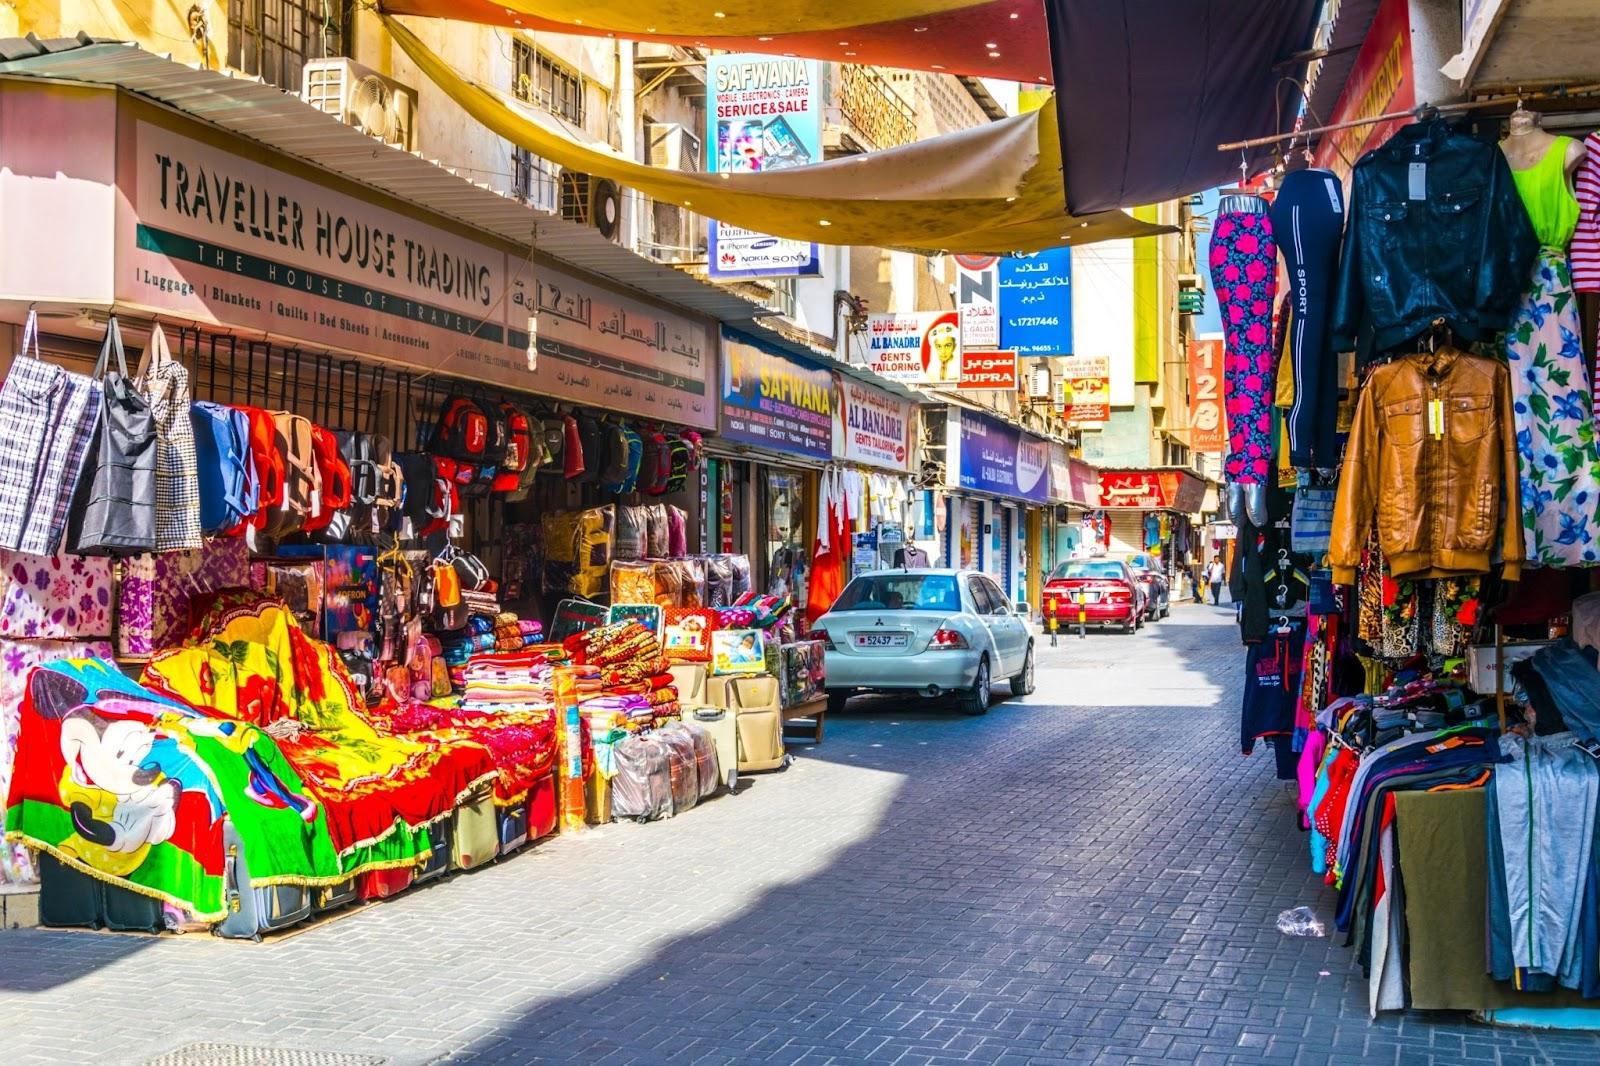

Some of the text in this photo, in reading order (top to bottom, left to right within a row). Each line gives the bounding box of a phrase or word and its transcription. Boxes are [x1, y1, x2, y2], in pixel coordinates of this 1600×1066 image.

[717, 59, 809, 92] SAFWANA
[717, 88, 808, 103] MOBILE ELECTRONICS CAMERA
[155, 153, 491, 306] TRAVELLER HOUSE TRADING
[772, 254, 808, 263] SONY
[198, 244, 473, 333] THE HOUSE OF TRAVEL
[1297, 269, 1307, 315] SPORT
[144, 268, 430, 350] Luggage Blankets Quilts Bed Sheets Accessories
[1017, 317, 1059, 327] 17217446
[599, 309, 667, 351] المسافر
[871, 336, 921, 349] AL BANADRH
[671, 334, 700, 367] بيت
[880, 353, 911, 361] GENTS
[871, 363, 921, 372] TAILORING
[759, 365, 831, 415] SAFWANA
[769, 428, 786, 440] SONY
[848, 403, 860, 429] AL
[862, 407, 902, 442] BANADRH
[855, 432, 896, 453] GENTS TAILORING
[700, 458, 708, 553] MOBILE
[867, 635, 891, 645] 52437
